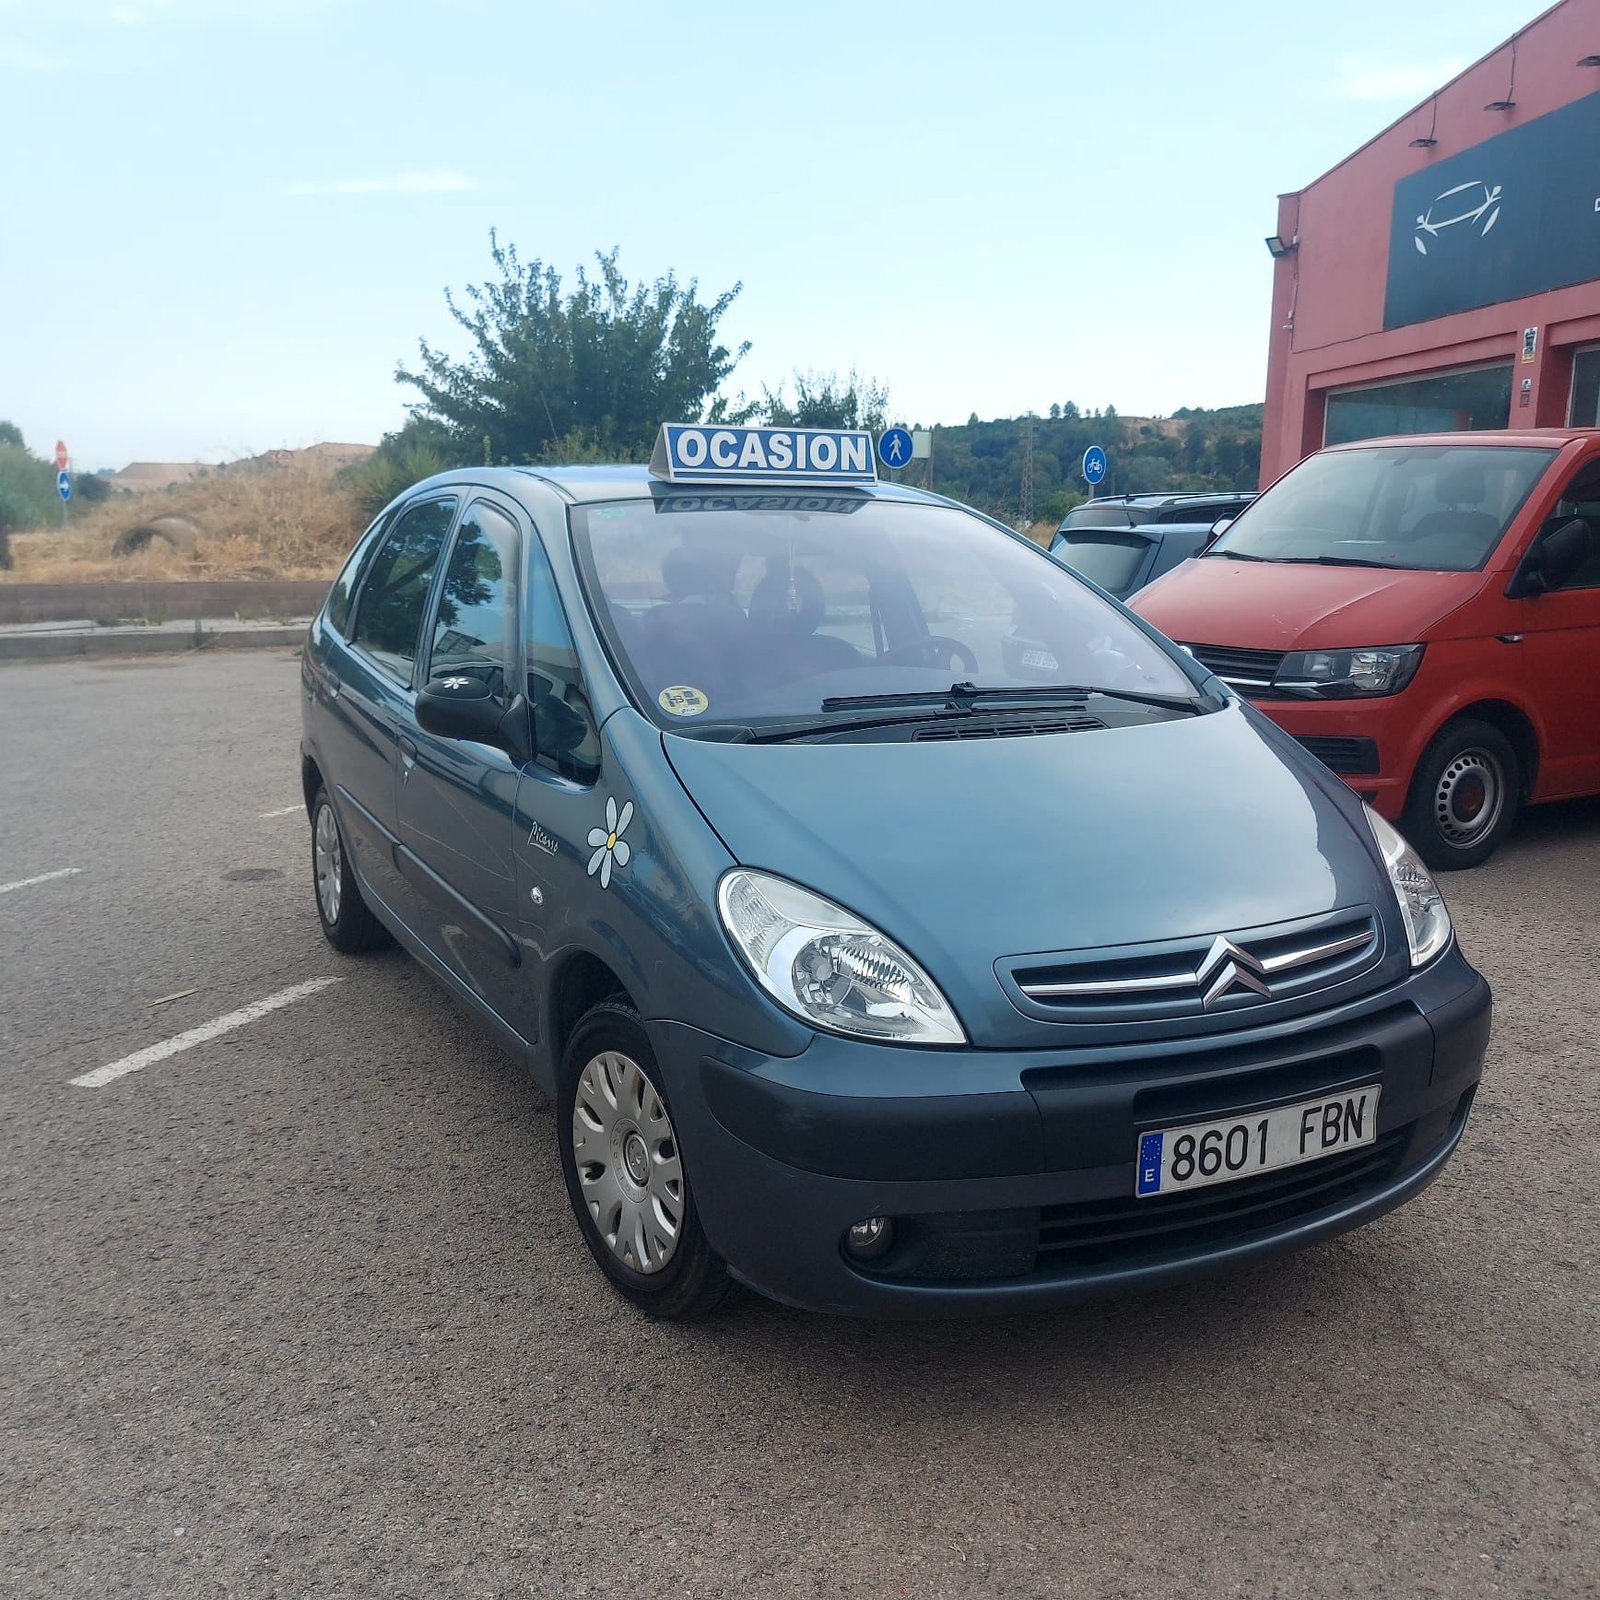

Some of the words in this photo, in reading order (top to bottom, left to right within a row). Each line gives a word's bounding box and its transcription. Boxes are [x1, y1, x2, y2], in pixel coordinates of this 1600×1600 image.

[676, 430, 867, 471] OCASION
[1144, 1168, 1156, 1183] E
[1171, 1119, 1269, 1182] 8601
[1300, 1095, 1367, 1155] FBN
